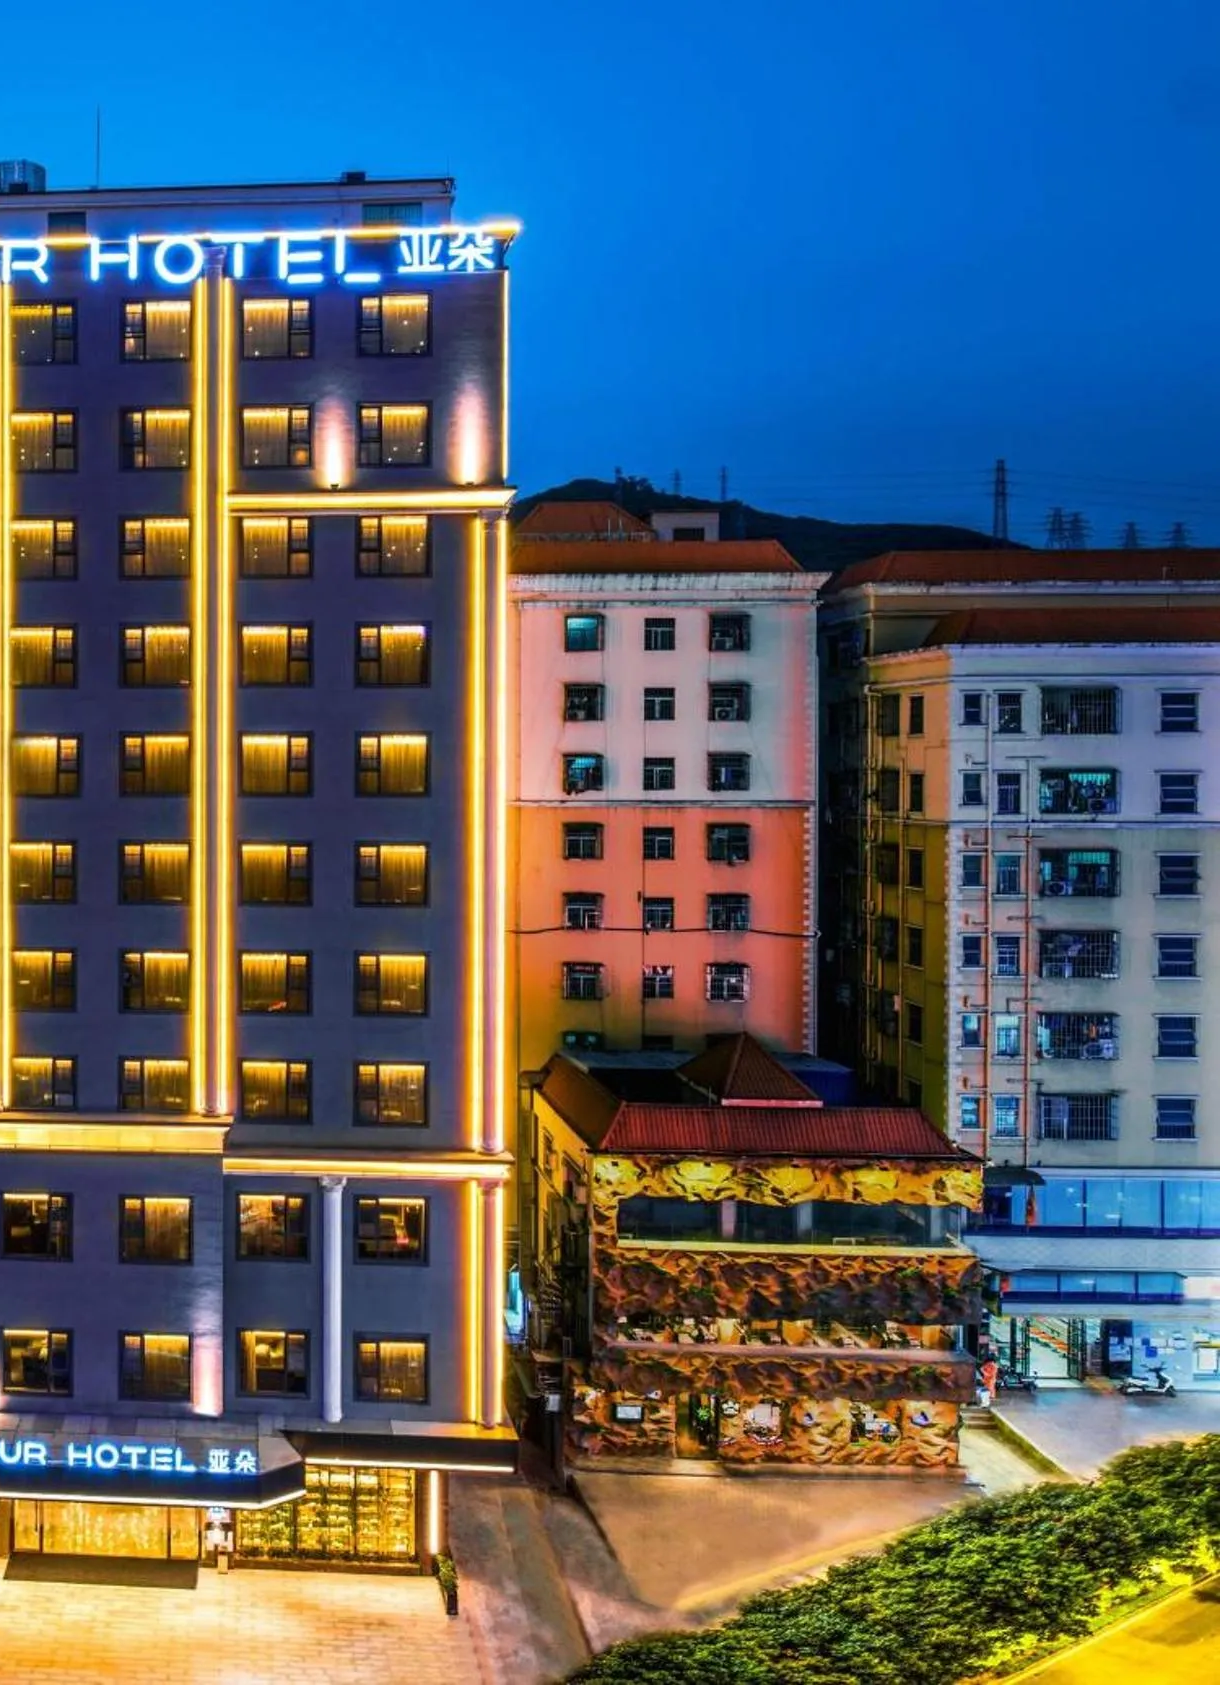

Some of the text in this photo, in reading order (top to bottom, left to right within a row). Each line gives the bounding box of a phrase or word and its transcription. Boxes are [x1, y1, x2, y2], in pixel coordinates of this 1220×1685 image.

[90, 228, 382, 285] HOTEL
[397, 228, 496, 273] 亚朵
[67, 1442, 197, 1473] HOTEL
[207, 1448, 257, 1473] 亚朵
